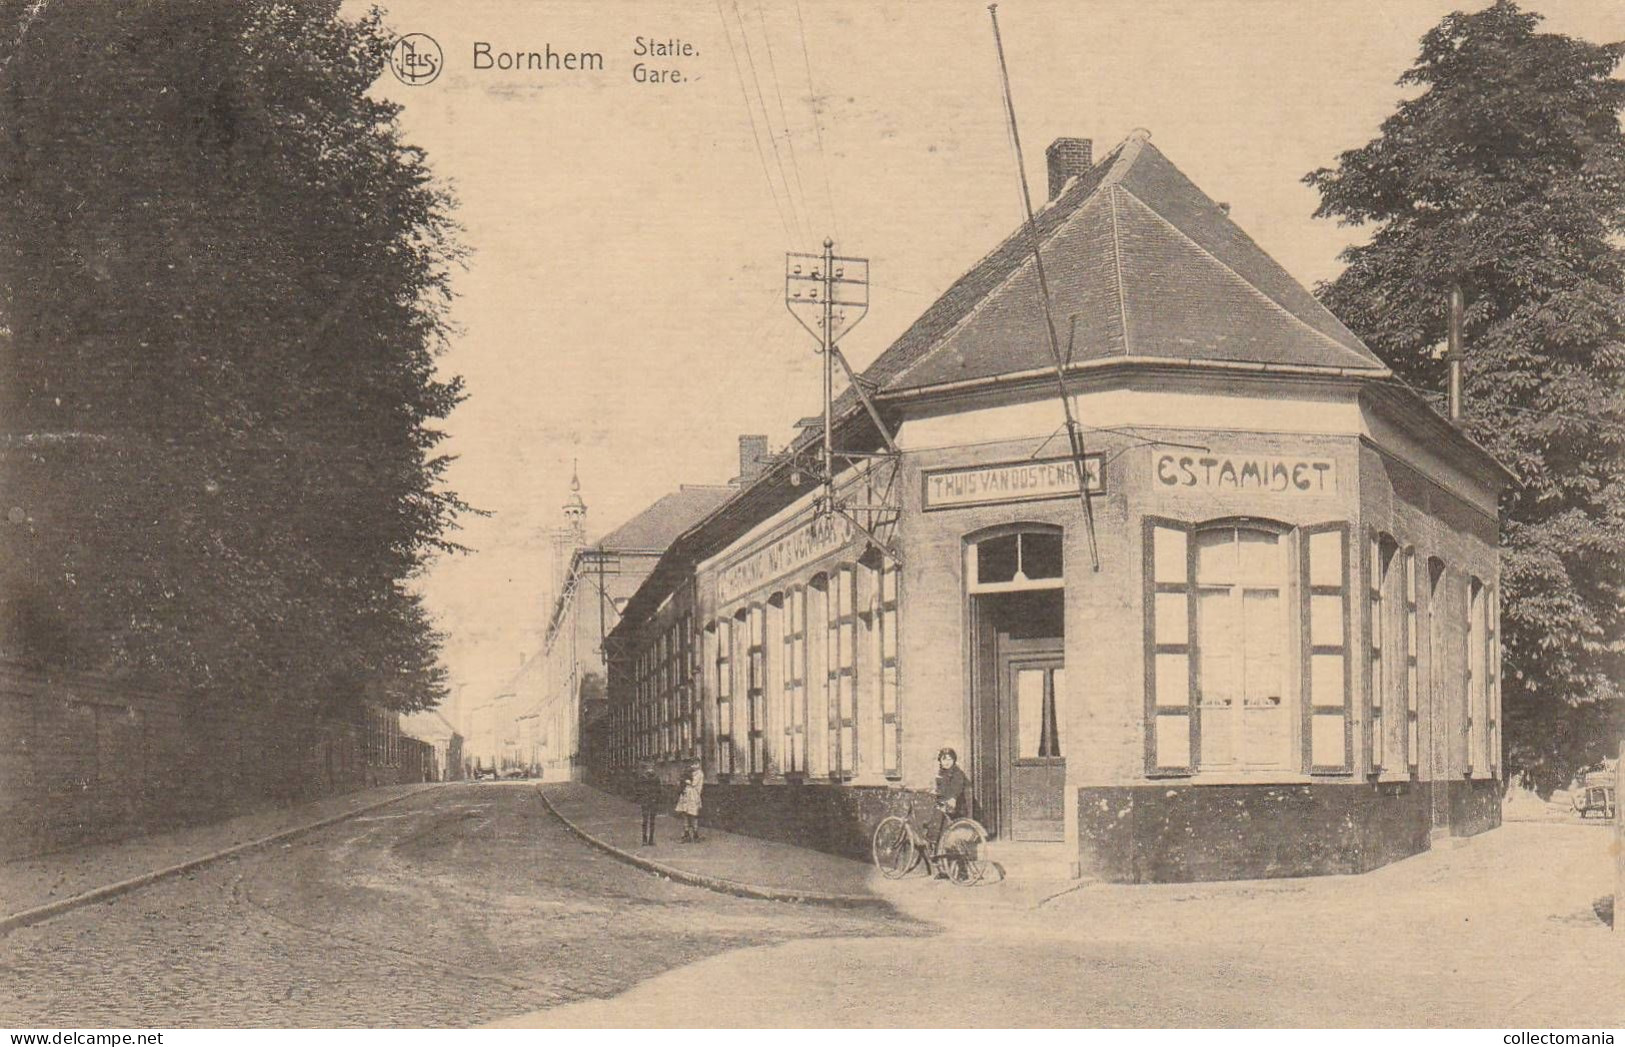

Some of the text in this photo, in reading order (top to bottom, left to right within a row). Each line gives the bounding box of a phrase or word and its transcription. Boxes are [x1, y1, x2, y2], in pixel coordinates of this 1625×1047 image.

[979, 469, 1009, 492] VAN
[1011, 461, 1098, 490] OOSTENRK
[1157, 455, 1326, 492] ESTAMINET
